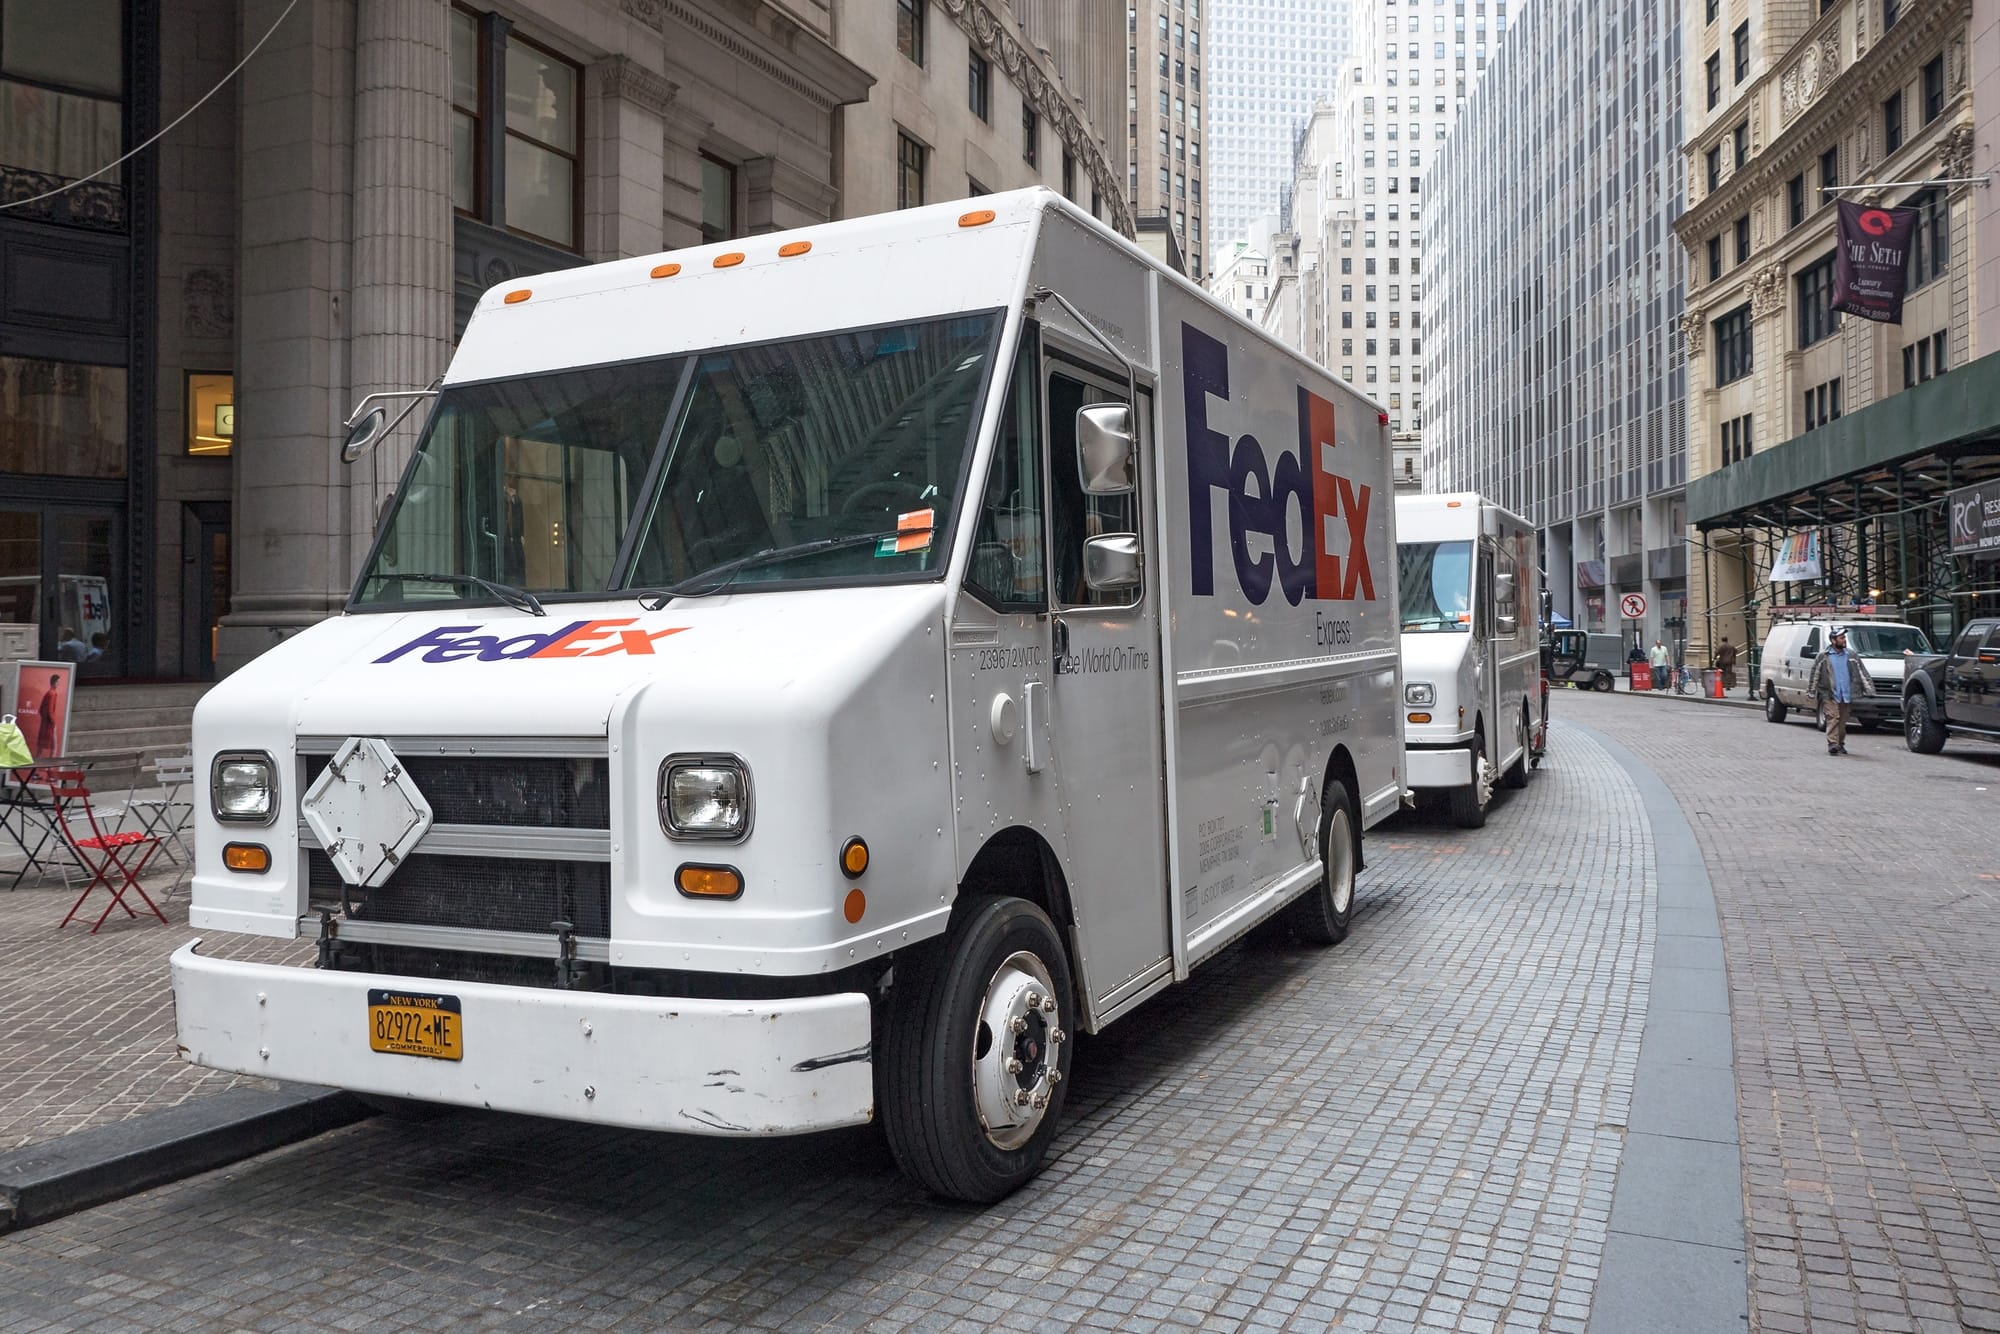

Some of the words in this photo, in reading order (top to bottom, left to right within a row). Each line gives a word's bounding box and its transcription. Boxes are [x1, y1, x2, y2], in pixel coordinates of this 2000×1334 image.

[1870, 241, 1902, 266] SETAI
[1858, 278, 1882, 288] Luxury
[1182, 320, 1376, 608] FedEx
[370, 617, 695, 664] FedEx
[1316, 611, 1351, 654] Express
[979, 645, 1041, 671] 239672WTC
[1082, 647, 1112, 674] World
[1113, 647, 1127, 672] On
[1127, 646, 1149, 671] Time
[390, 995, 412, 1007] NEW
[412, 997, 438, 1009] YORK
[376, 1010, 423, 1044] 82922
[433, 1014, 452, 1047] ME
[390, 1043, 441, 1054] COMMERCIAL
